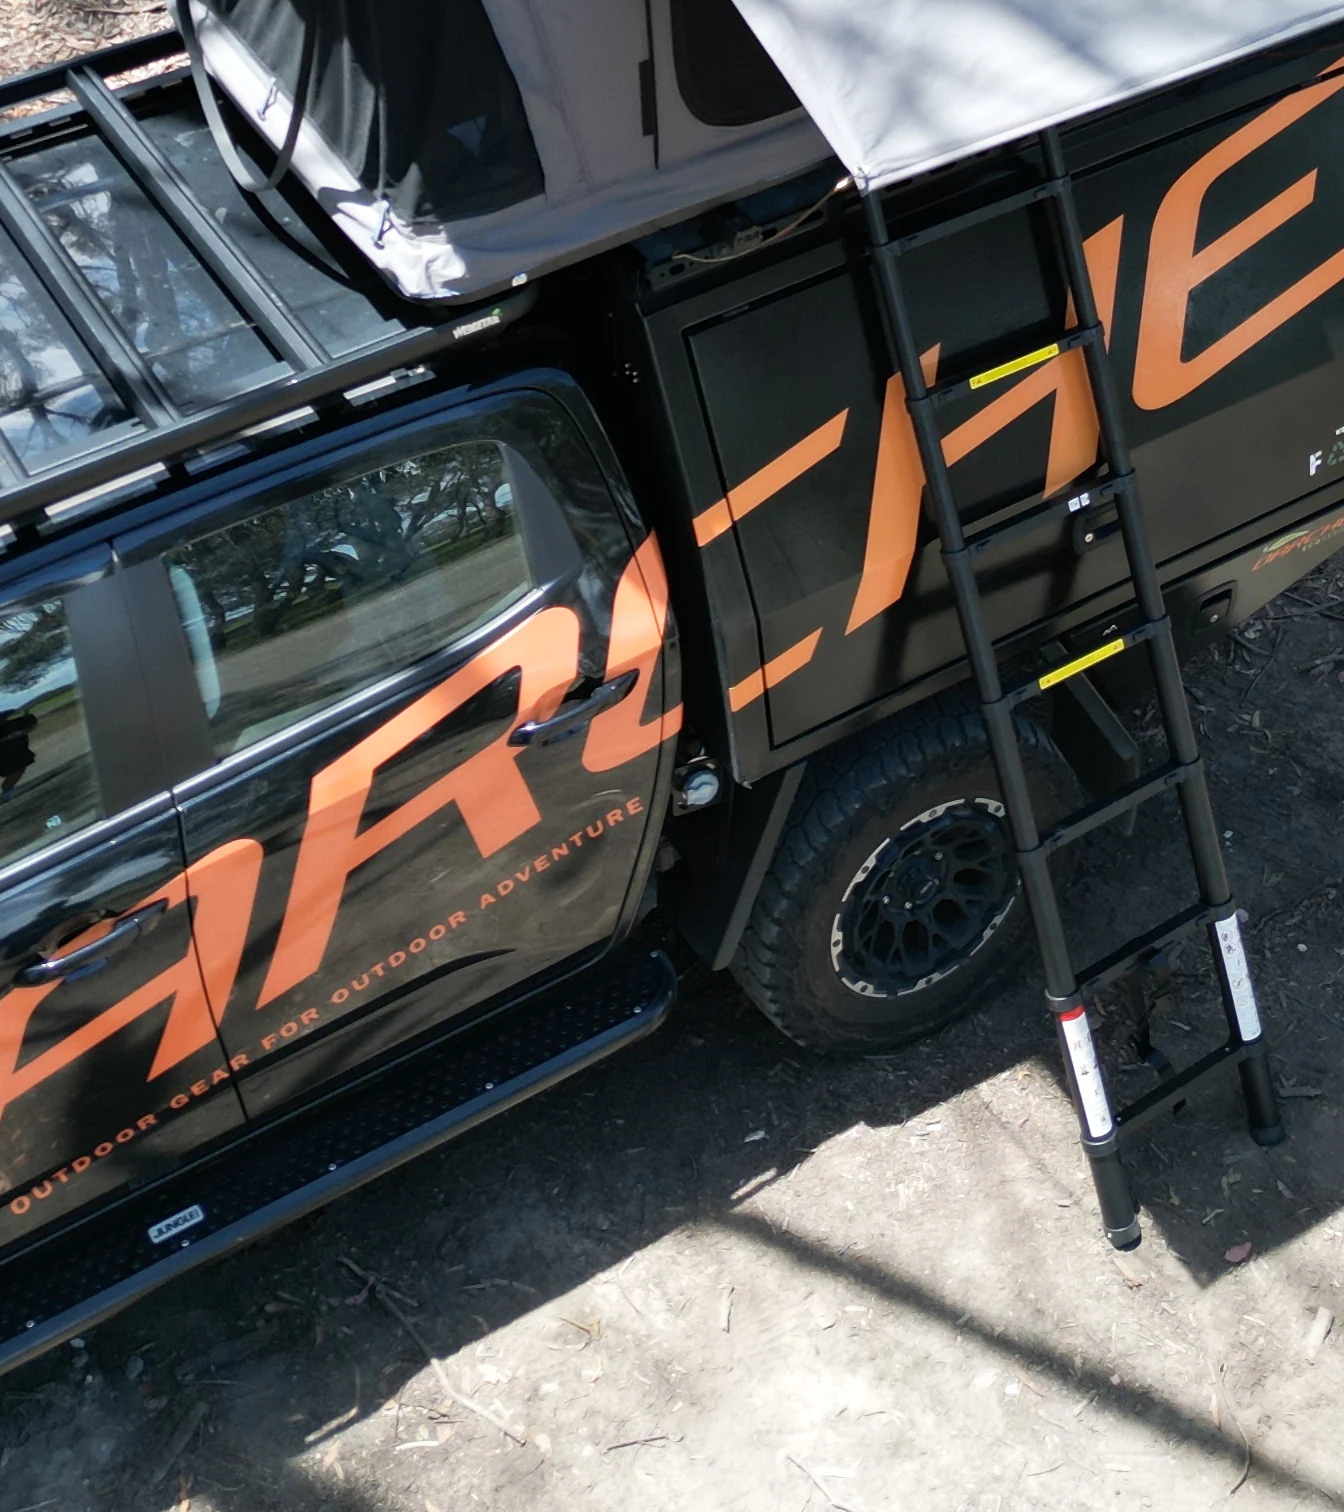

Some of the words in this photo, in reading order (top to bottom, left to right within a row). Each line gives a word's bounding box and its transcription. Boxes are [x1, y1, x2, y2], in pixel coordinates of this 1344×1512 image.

[9, 1112, 157, 1216] OUTDOOR
[169, 1052, 252, 1111] GEAR
[261, 1006, 321, 1052] FOR
[330, 909, 468, 1005] OUTDOOR
[480, 796, 646, 909] ADVENTURE
